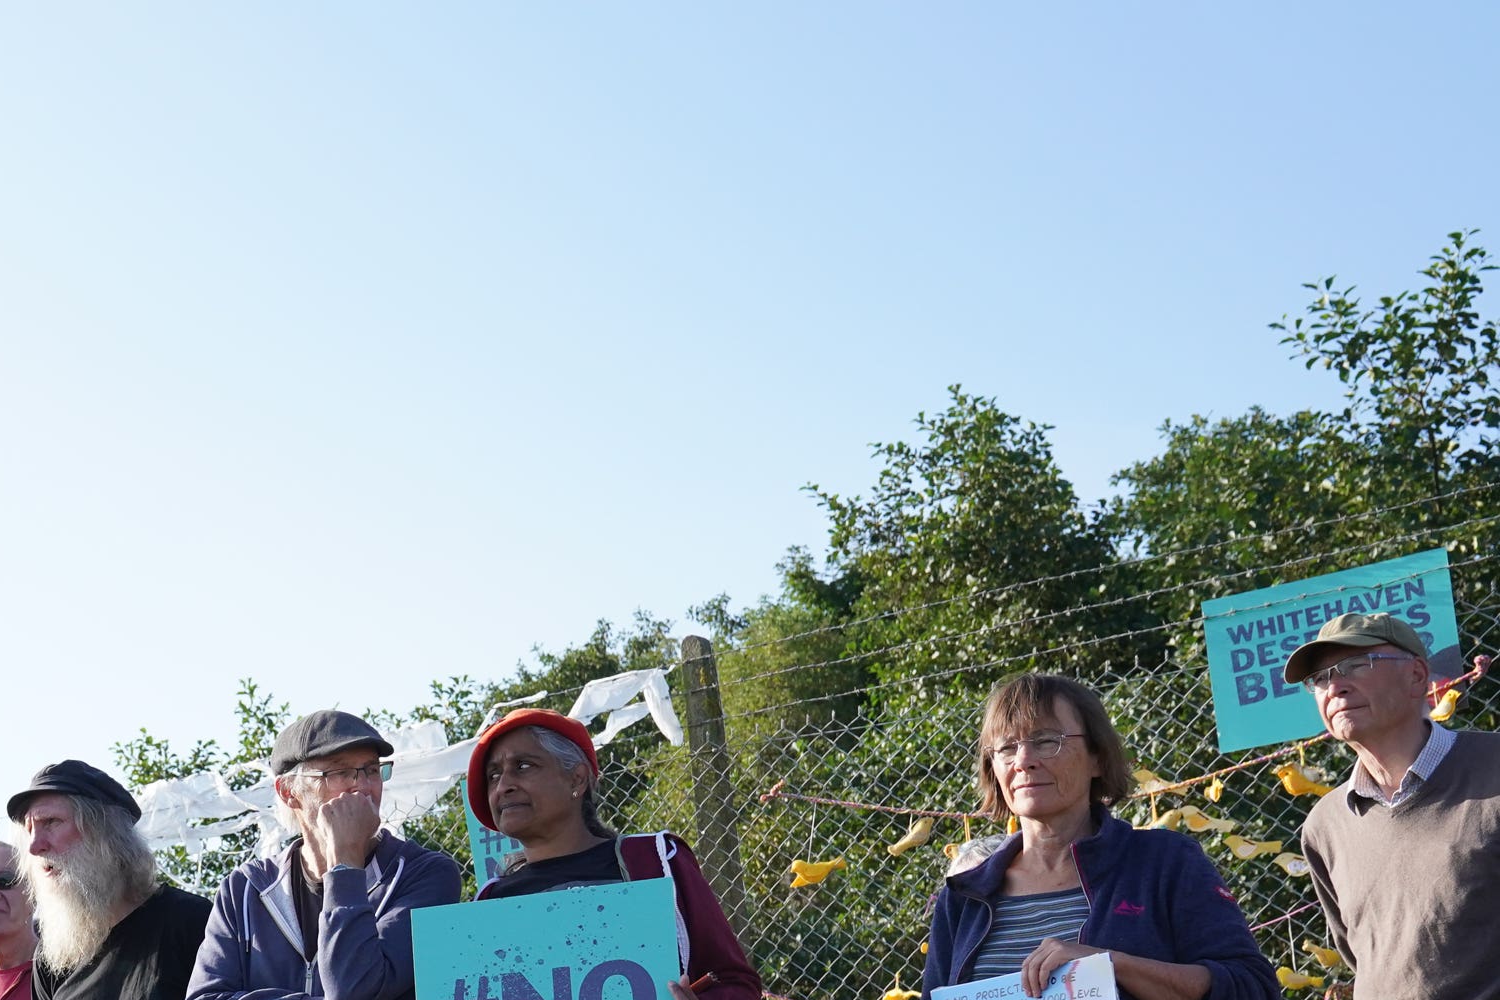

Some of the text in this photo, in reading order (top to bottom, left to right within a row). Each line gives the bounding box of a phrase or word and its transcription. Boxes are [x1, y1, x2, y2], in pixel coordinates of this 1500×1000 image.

[1226, 578, 1426, 645] WHITEHAVEN
[976, 984, 1026, 1000] PROJECT
[1061, 971, 1076, 983] BE
[1071, 987, 1102, 1000] LEVEL
